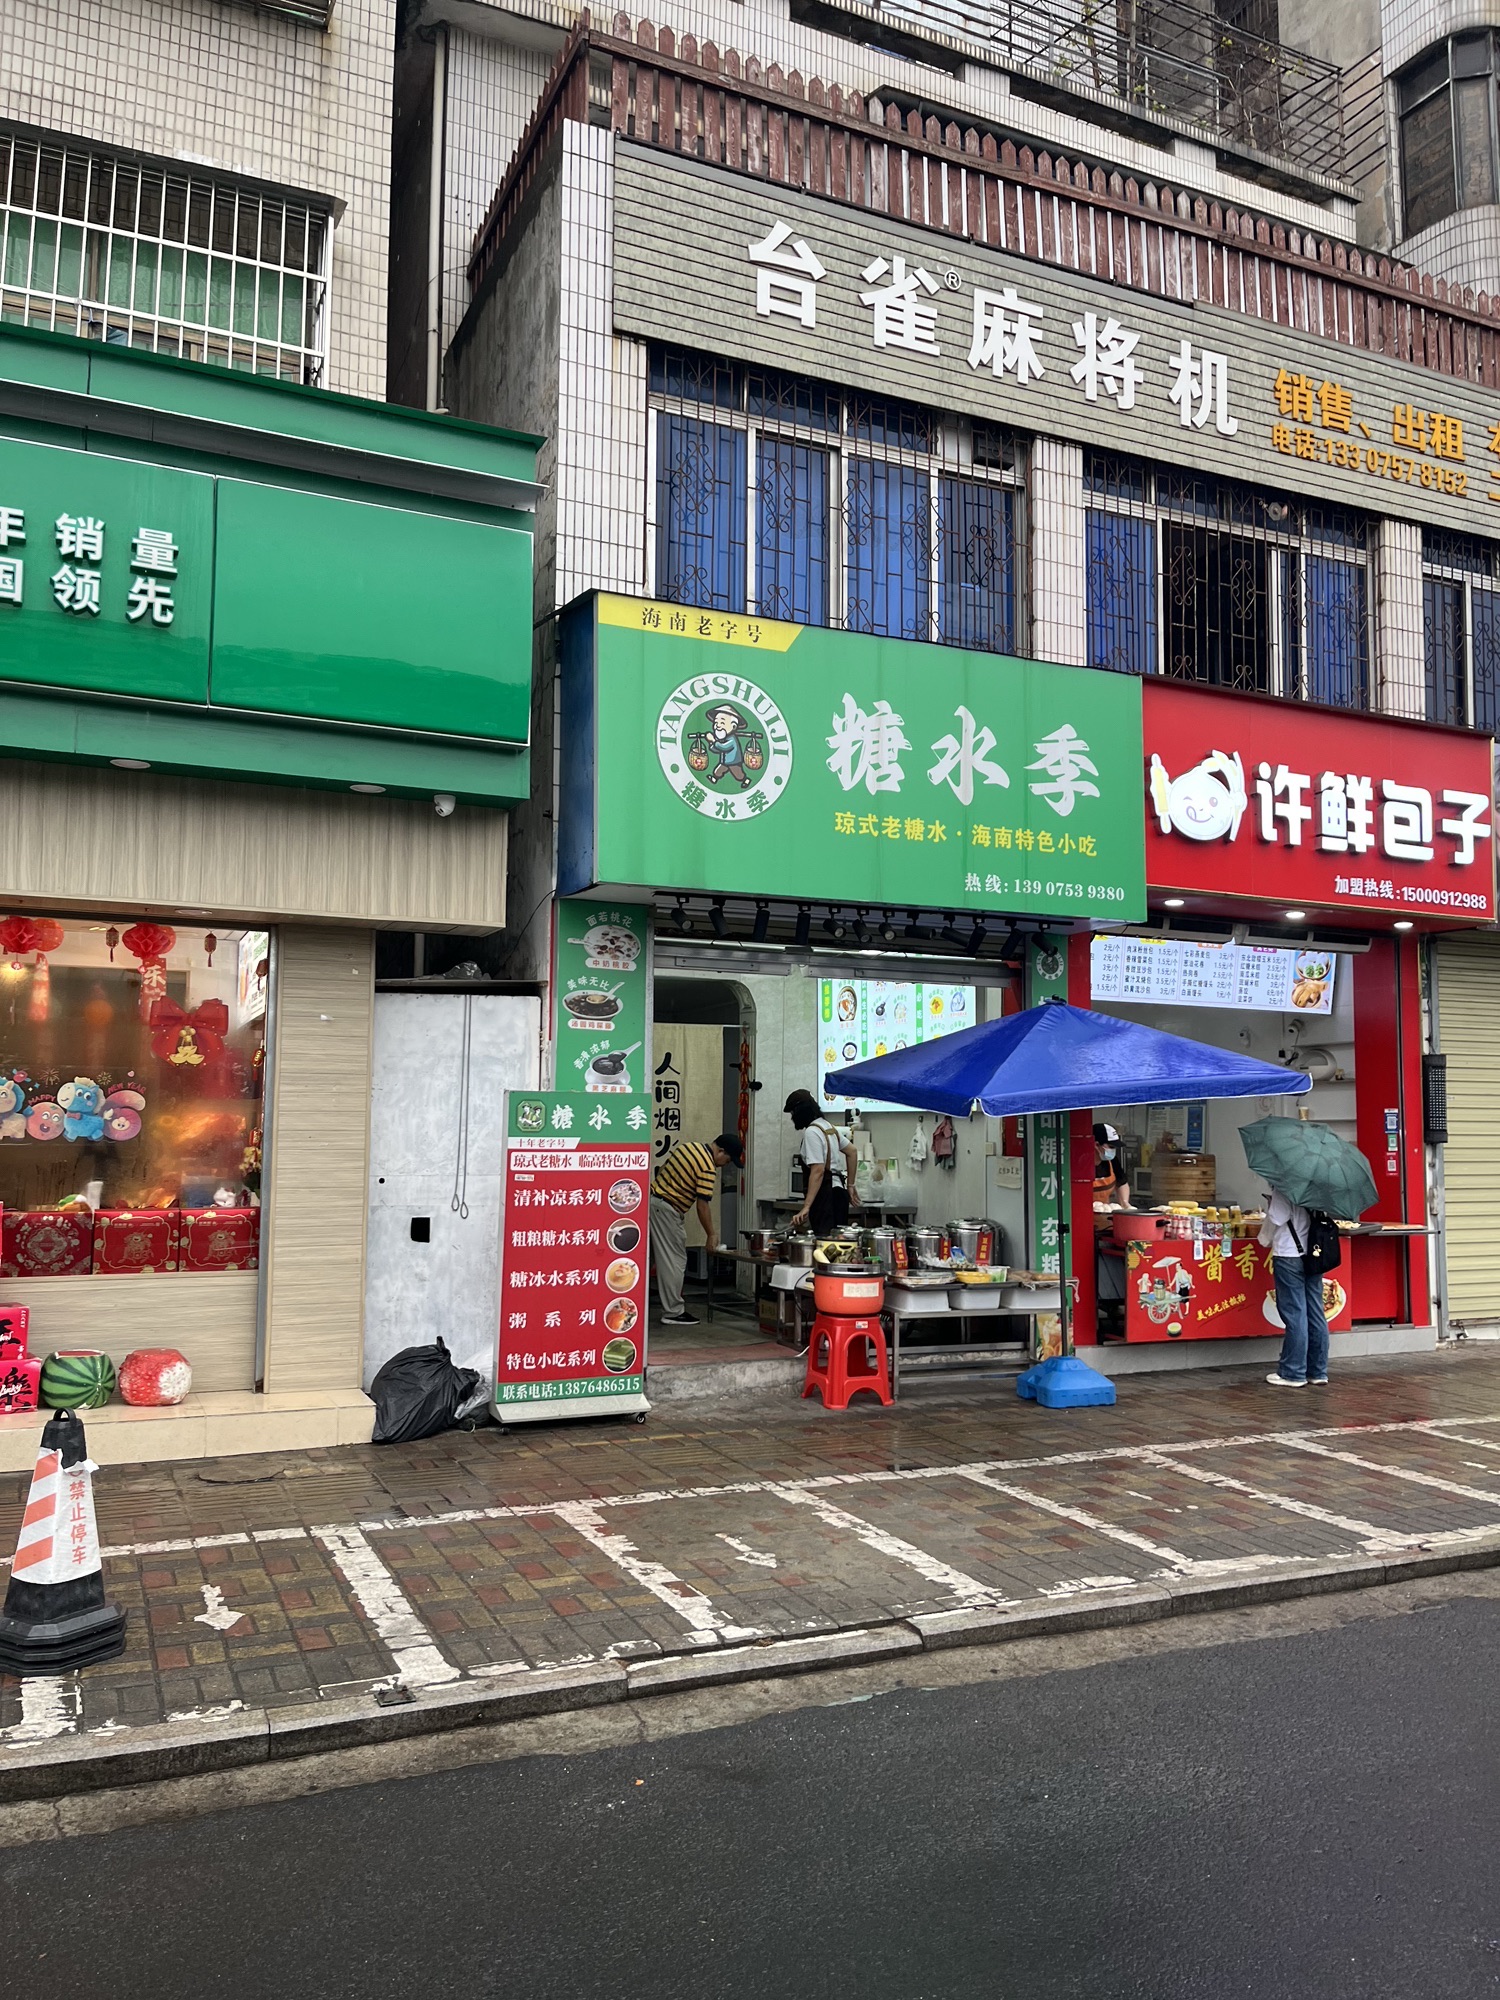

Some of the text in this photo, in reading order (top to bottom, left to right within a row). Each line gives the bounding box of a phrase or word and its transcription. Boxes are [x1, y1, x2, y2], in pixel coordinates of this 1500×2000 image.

[748, 219, 1238, 436] 台雀麻将机
[1274, 368, 1466, 462] 销售、出租
[1366, 449, 1414, 482] 0757
[1420, 463, 1468, 496] 8152
[642, 607, 762, 644] 海南老字号
[660, 676, 789, 757] TANGSHUIJI
[825, 692, 1100, 817] 糖水季
[681, 781, 769, 819] 糖水季
[1256, 761, 1491, 865] 许鲜包子
[1014, 879, 1042, 895] 139
[1046, 881, 1083, 898] 0753
[1087, 884, 1124, 901] 9380
[586, 911, 633, 928] 面若桃花
[1103, 943, 1120, 953] 2元/个
[1103, 953, 1120, 962] 2元/个
[1101, 974, 1118, 983] 2元/个
[1102, 964, 1119, 973] 3元/个
[567, 975, 610, 991] 美味无比
[108, 1081, 147, 1094] NEW YEAR
[28, 1094, 56, 1105] HAPPY
[551, 1103, 648, 1130] 糖水季
[654, 1051, 681, 1178] 人间烟火
[516, 1137, 566, 1149] 十年老字号
[513, 1153, 646, 1169] 琼式老糖水 临高特色小吃
[513, 1188, 602, 1207] 清补凉系列
[511, 1228, 600, 1247] 粗粮糖水系列
[509, 1268, 599, 1288] 糖冰水系列
[508, 1308, 597, 1329] 粥系列
[506, 1349, 596, 1371] 特色小吃系列
[502, 1377, 640, 1400] 联系电话:13876486515
[69, 1479, 87, 1565] 禁止停车
